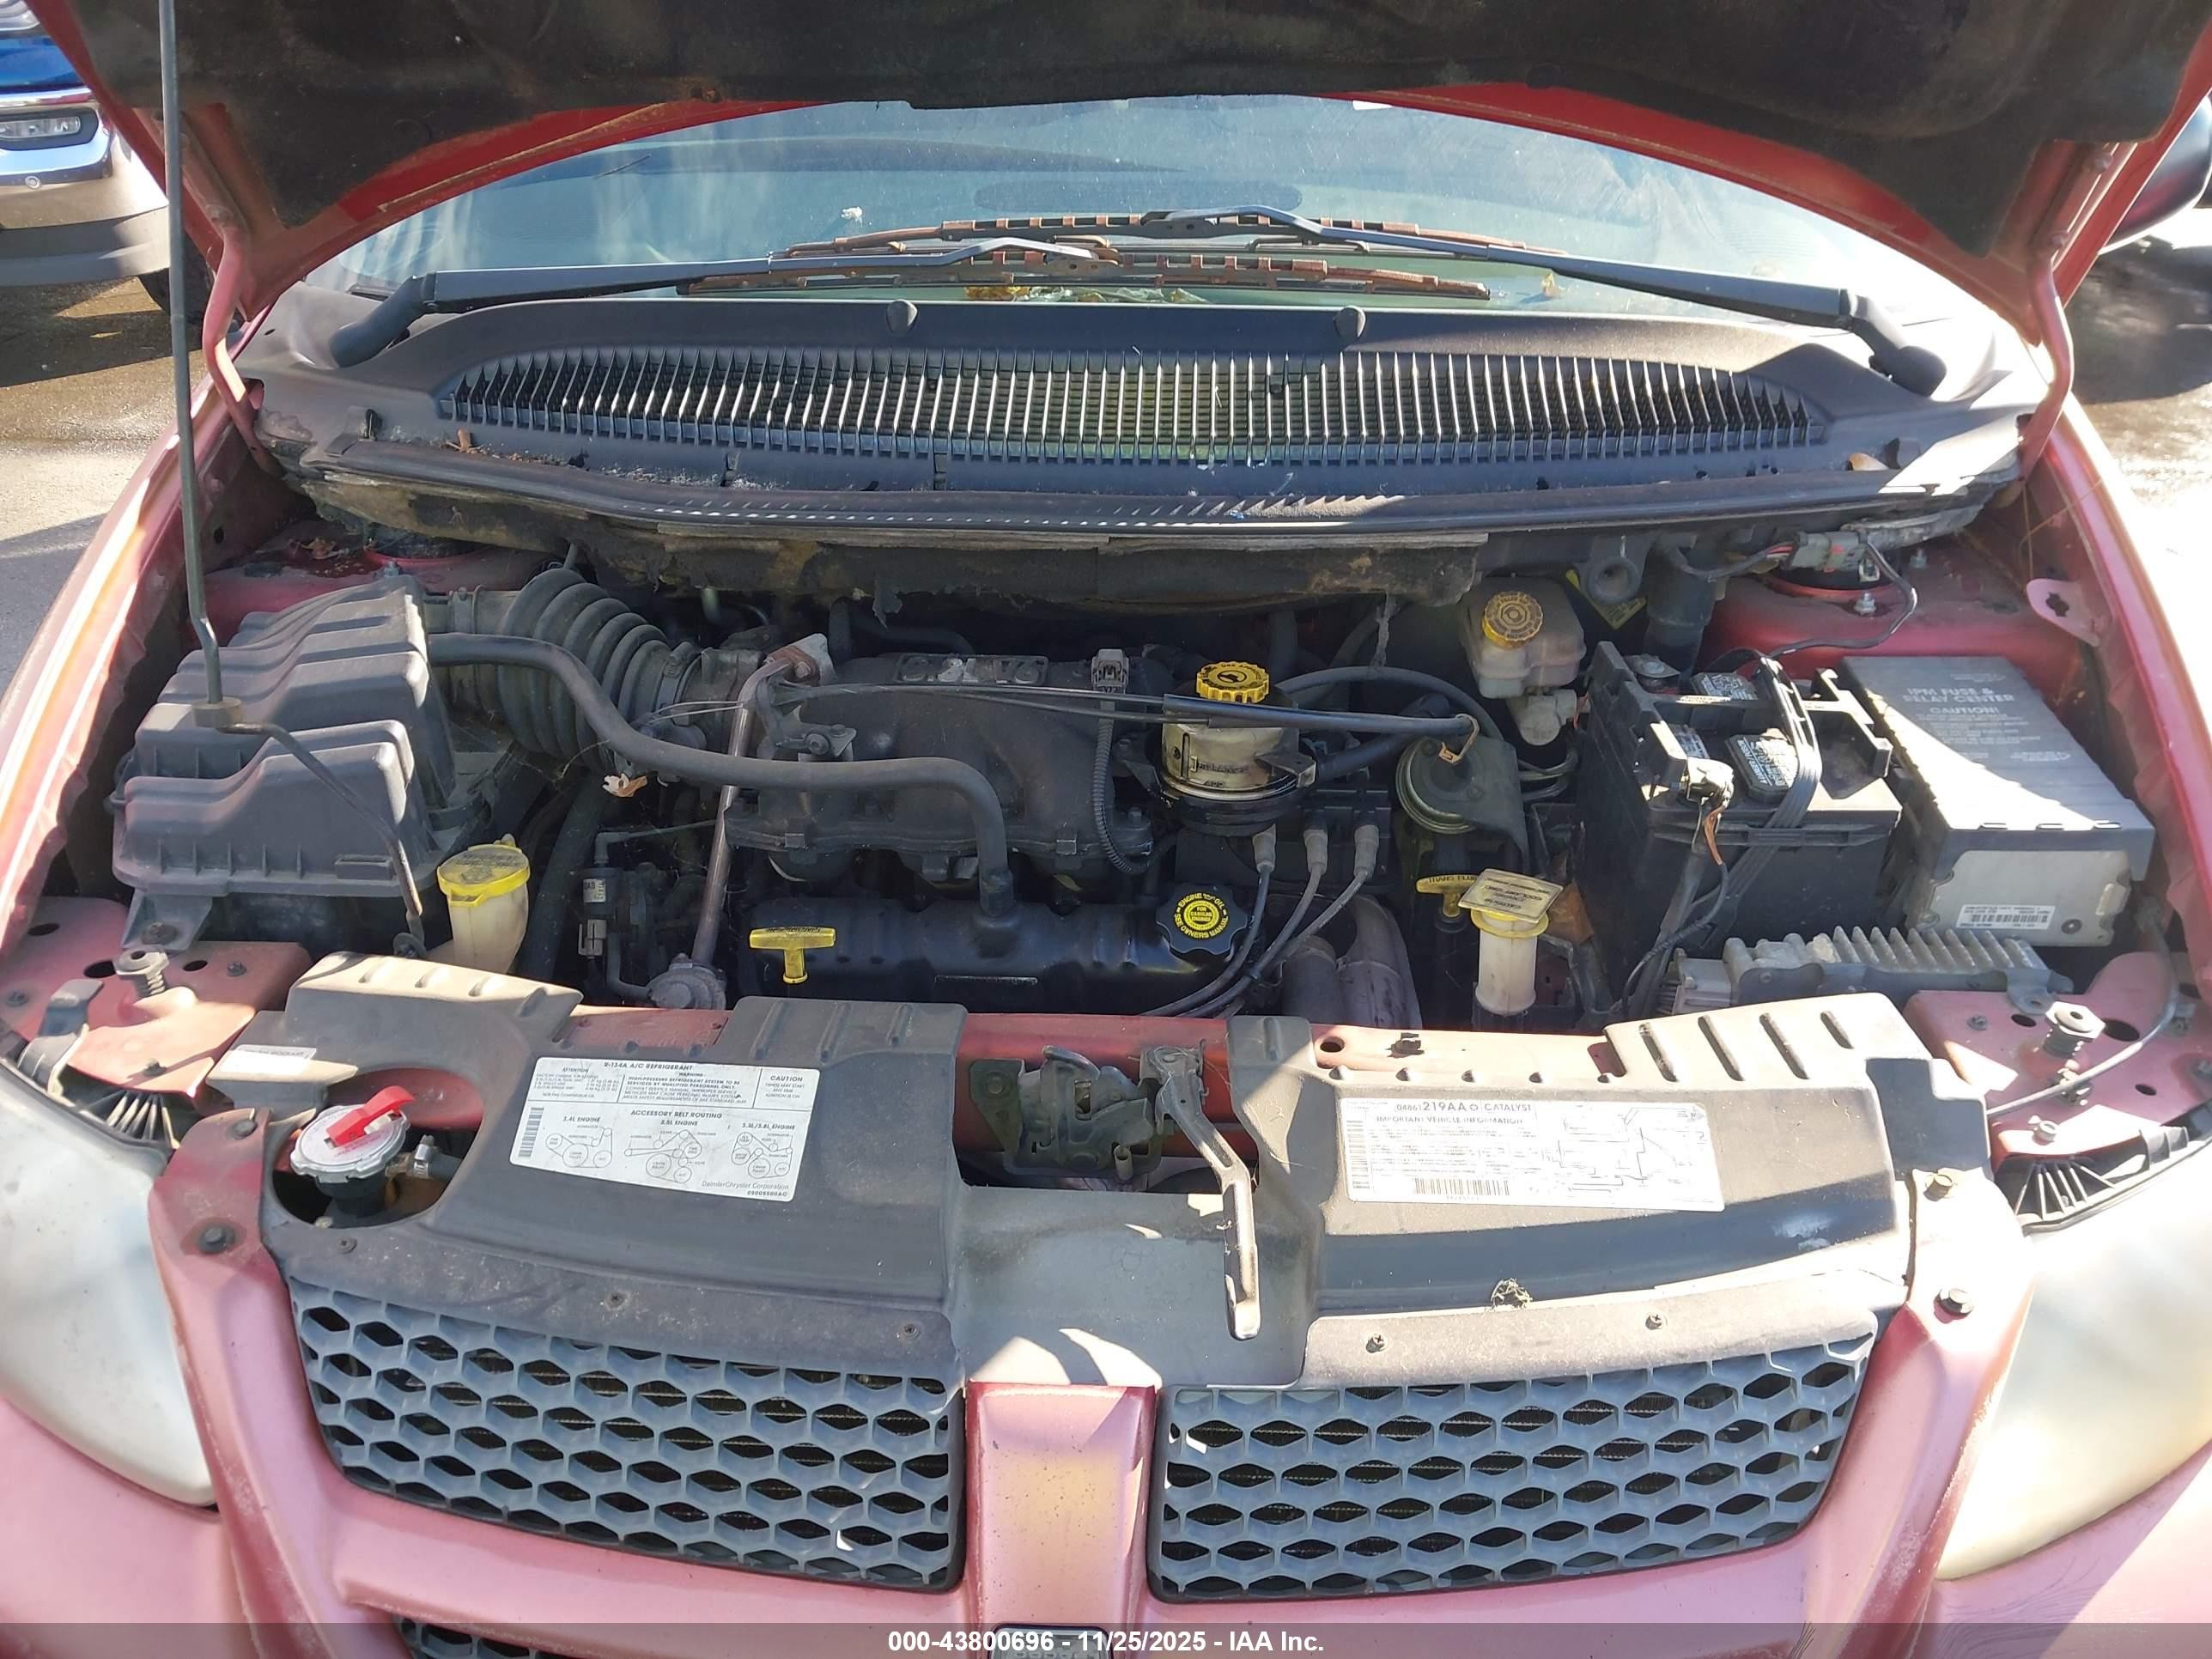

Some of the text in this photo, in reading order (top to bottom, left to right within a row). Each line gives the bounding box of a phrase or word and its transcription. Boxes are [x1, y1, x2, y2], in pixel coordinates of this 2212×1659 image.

[1954, 694, 2014, 702] CENTER
[1178, 892, 1203, 907] ENGINE
[1174, 913, 1229, 939] SEE OWNERS MANUAL
[1484, 1103, 1532, 1112] CATALYST
[702, 1180, 789, 1190] DaimlerChrysler Corporation
